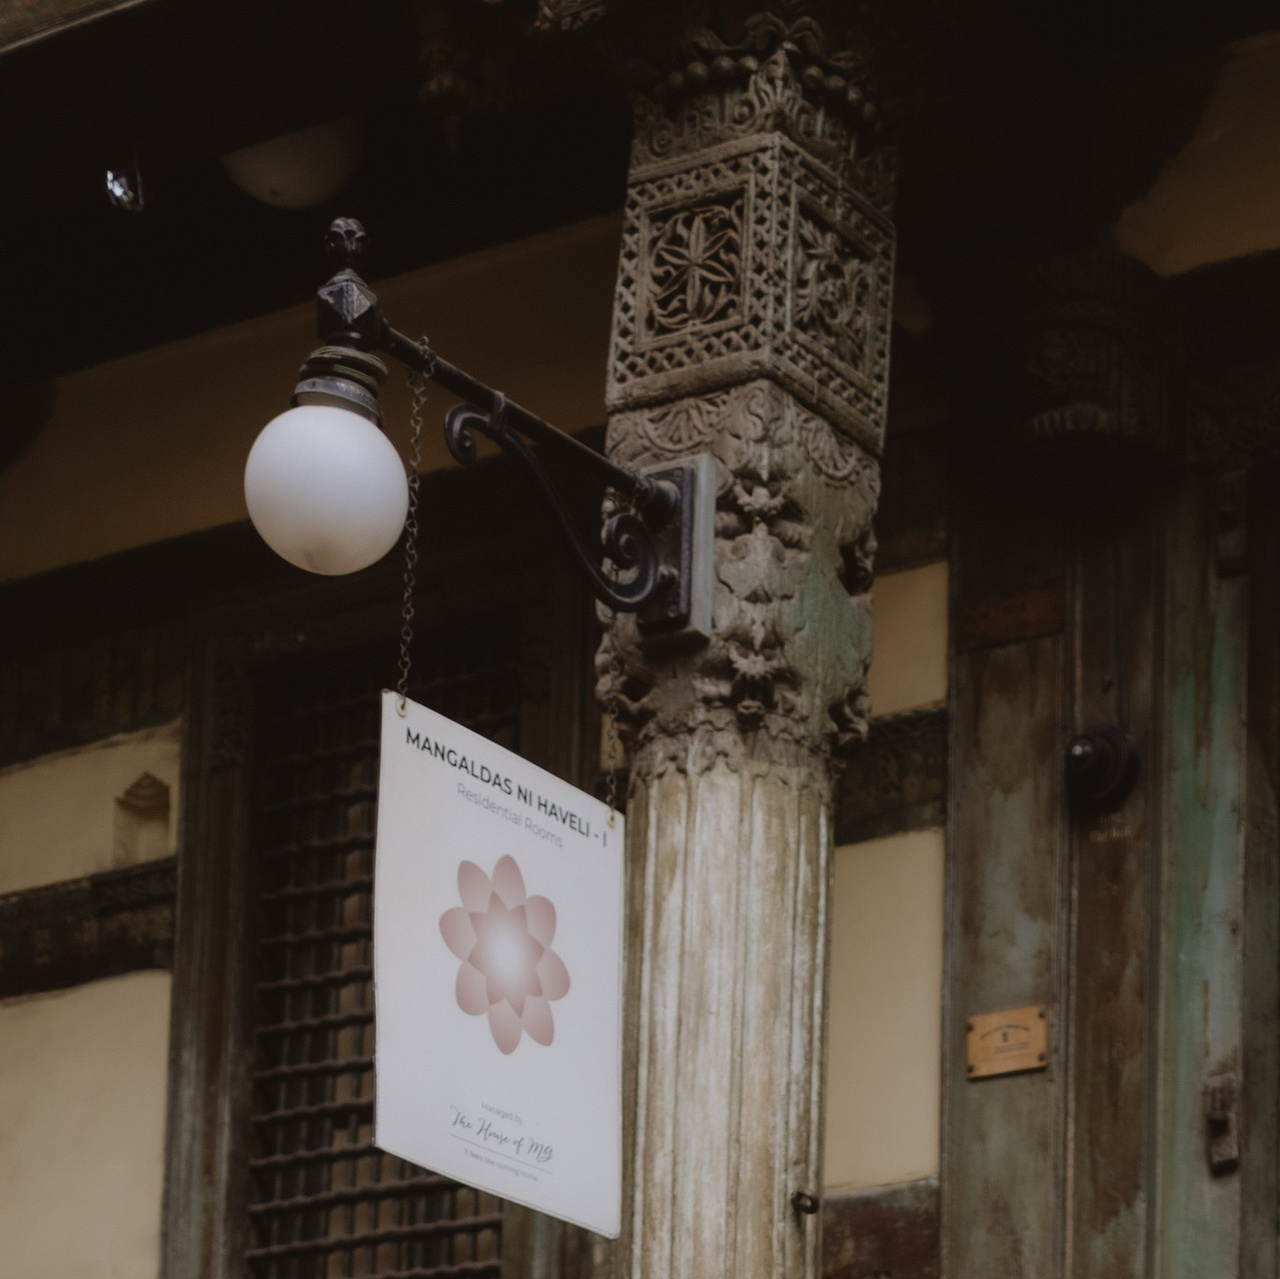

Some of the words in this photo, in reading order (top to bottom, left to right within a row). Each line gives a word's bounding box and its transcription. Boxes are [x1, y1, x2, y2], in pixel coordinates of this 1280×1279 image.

[406, 727, 513, 796] MANGALDAS
[517, 784, 533, 807] NI
[537, 795, 590, 838] HAVELI
[457, 782, 522, 826] Residential
[524, 817, 563, 849] Rooms
[450, 1104, 472, 1129] The
[476, 1117, 510, 1145] House
[513, 1137, 525, 1155] of
[527, 1137, 554, 1163] MG
